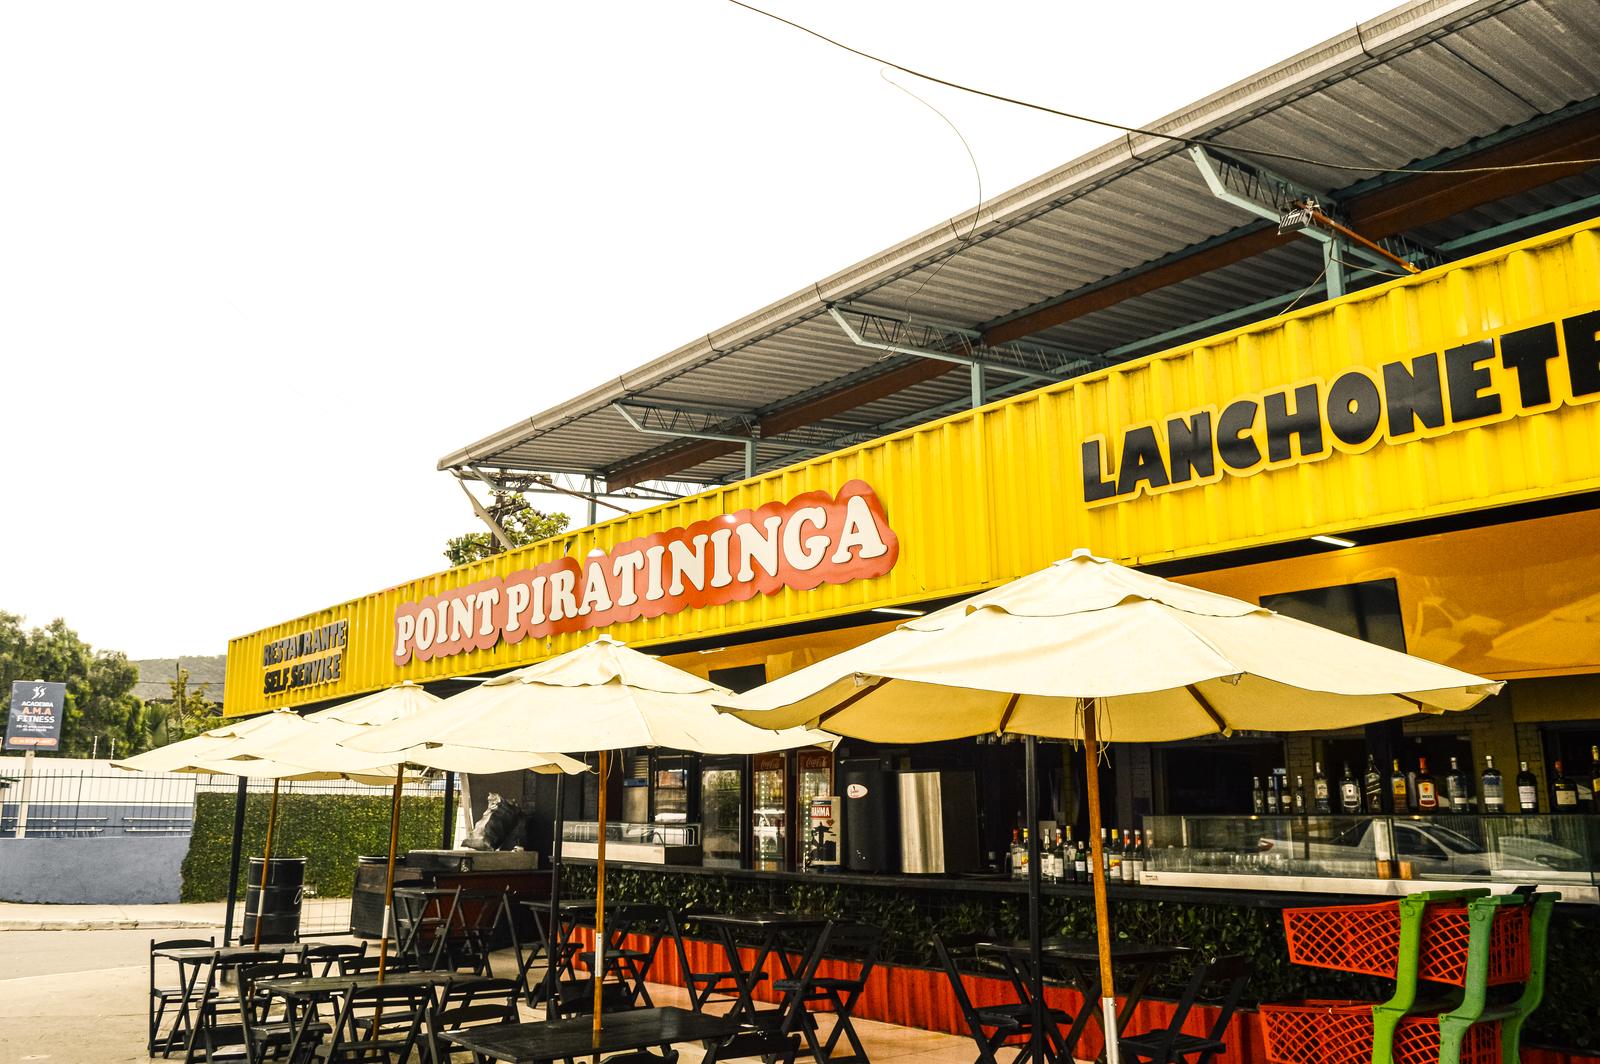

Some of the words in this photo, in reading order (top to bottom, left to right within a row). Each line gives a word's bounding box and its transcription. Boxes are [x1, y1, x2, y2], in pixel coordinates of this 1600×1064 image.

[1081, 310, 1600, 503] LANCHONETE
[395, 588, 500, 656] POINT
[506, 495, 888, 632] PIRATININGA
[263, 620, 346, 667] RESTAURANTE
[264, 667, 290, 694] SELF
[289, 653, 341, 688] SERVICE
[16, 714, 55, 723] FITNESS
